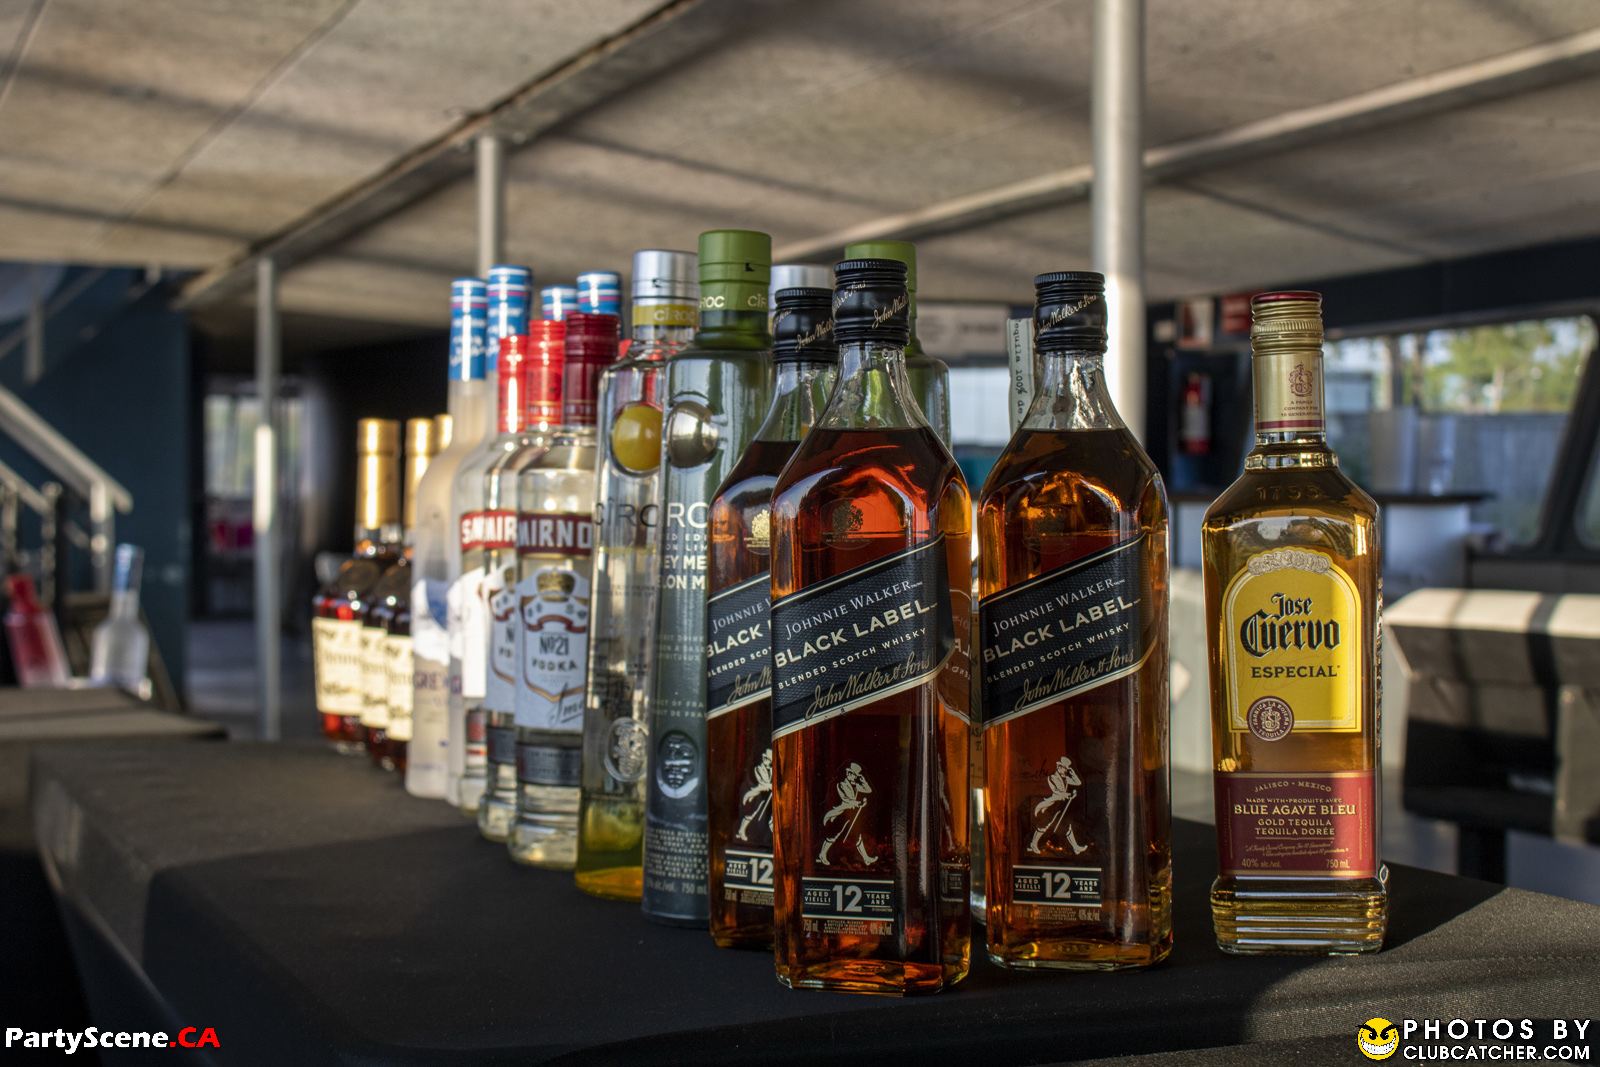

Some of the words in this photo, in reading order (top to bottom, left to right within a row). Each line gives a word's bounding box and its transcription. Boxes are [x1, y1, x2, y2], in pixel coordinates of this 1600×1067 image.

[711, 602, 764, 634] JOHNNIE
[785, 604, 849, 640] JOHNNIE
[850, 579, 913, 611] WALKER
[993, 601, 1055, 638] JOHNNIE
[1055, 578, 1115, 609] WALKER
[1270, 592, 1313, 619] Jose
[775, 627, 847, 669] BLACK
[853, 598, 931, 638] LABEL
[983, 623, 1055, 663] BLACK
[1059, 595, 1134, 633] LABEL
[1240, 608, 1341, 658] Cuervo
[778, 665, 827, 690] BLENDED
[832, 646, 877, 669] SCOTCH
[881, 627, 928, 650] WHISKY
[986, 659, 1035, 684] BLENDED
[1040, 641, 1083, 663] SCOTCH
[1086, 622, 1131, 645] WHISKY
[1251, 665, 1338, 679] ESPECIAL
[1254, 780, 1290, 793] JALISCO
[1297, 780, 1332, 793] MEXICO
[1234, 804, 1269, 815] BLUE
[1272, 804, 1317, 815] AGAVE
[1321, 804, 1356, 815] BLEU
[1257, 818, 1285, 826] GOLD
[1288, 818, 1332, 827] TEQUILA
[1255, 828, 1298, 836] TEQUILA
[1301, 826, 1335, 836] DORÉE
[749, 857, 774, 885] 12
[1041, 872, 1072, 899] 12
[831, 884, 863, 913] 12
